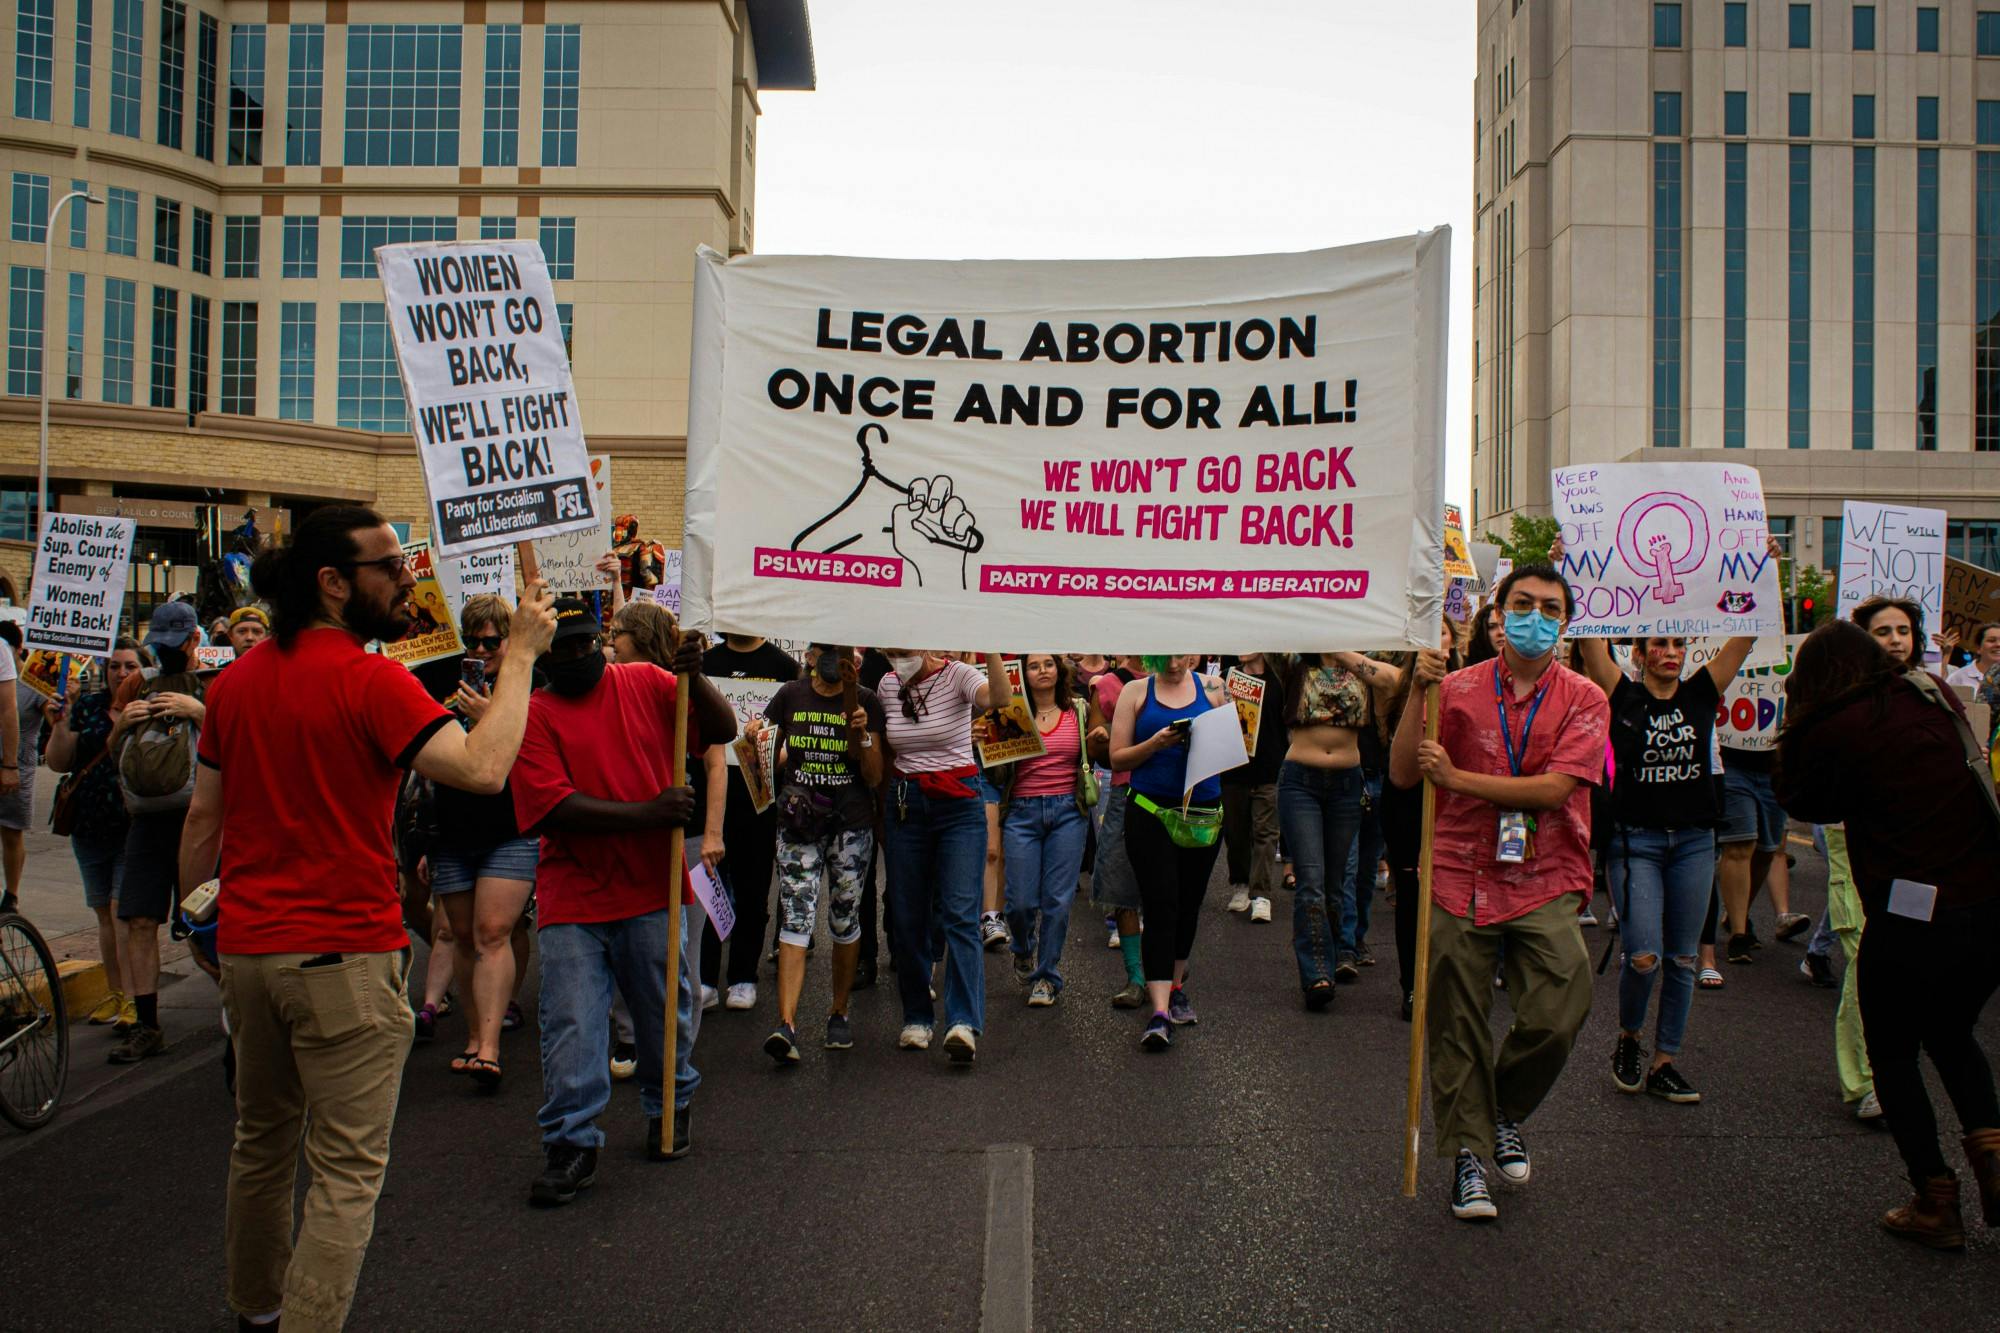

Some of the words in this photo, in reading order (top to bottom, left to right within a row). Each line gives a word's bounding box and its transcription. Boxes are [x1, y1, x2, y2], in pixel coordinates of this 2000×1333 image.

[414, 254, 521, 296] WOMEN
[407, 299, 497, 343] WON'T
[505, 296, 543, 335] GO
[816, 307, 1003, 360] LEGAL
[1019, 314, 1317, 363] ABORTION
[447, 343, 529, 386] BACK,
[767, 368, 936, 420] ONCE
[953, 383, 1083, 426] AND
[1106, 387, 1221, 429] FOR
[1238, 379, 1357, 428] ALL!
[420, 400, 499, 445] WE'LL
[501, 391, 569, 434] FIGHT
[461, 436, 554, 487] BACK!
[1044, 460, 1080, 492] WE
[1091, 458, 1187, 493] WON'T
[1197, 455, 1241, 493] GO
[1256, 446, 1356, 492] BACK
[1555, 471, 1598, 488] KEEP
[445, 500, 475, 519] Party
[477, 496, 494, 512] for
[496, 489, 544, 510] Socialism
[554, 488, 588, 519] PSL
[1561, 485, 1600, 503] YOUR
[162, 510, 194, 519] COUNT
[1571, 503, 1603, 515] LAWS
[49, 517, 102, 538] Abolish
[105, 523, 125, 539] the
[460, 517, 481, 537] and
[483, 510, 537, 533] Liberation
[1020, 499, 1056, 530] WE
[1065, 501, 1124, 536] WILL
[1136, 504, 1228, 541] FIGHT
[1240, 504, 1353, 549] BACK!
[1560, 521, 1603, 546] OFF
[1849, 509, 1908, 545] WE
[1907, 525, 1939, 537] WILL
[43, 536, 73, 558] Sup.
[1719, 528, 1767, 550] OFF
[48, 557, 96, 581] Enemy
[99, 561, 114, 582] of
[492, 567, 502, 582] of
[759, 554, 897, 580] PSLWEB.ORG
[1562, 546, 1614, 582] MY
[1718, 552, 1770, 583] MY
[1871, 548, 1941, 584] NOT
[567, 573, 603, 592] Rights
[989, 571, 1051, 588] PARTY
[1058, 574, 1098, 590] FOR
[1104, 575, 1216, 592] SOCIALISM
[1221, 577, 1234, 592] &
[1241, 577, 1362, 593] LIBERATION
[46, 584, 105, 607] Women!
[1871, 580, 1941, 613] BACK!
[31, 605, 67, 628] Fight
[71, 610, 113, 631] Back!
[1568, 624, 1630, 637] SEPARATION
[1637, 624, 1652, 634] OF
[1656, 618, 1710, 634] CHURCH
[198, 648, 218, 658] PRO
[1740, 681, 1765, 696] OFF
[793, 712, 806, 722] AND
[808, 712, 821, 722] YOU
[1650, 708, 1684, 730] MIND
[813, 725, 828, 735] WAS
[830, 727, 835, 736] A
[1646, 725, 1697, 747] YOUR
[789, 735, 817, 748] NASTY
[820, 739, 848, 752] WOMA
[1643, 745, 1694, 762] OWN
[804, 751, 839, 763] BEFORE?
[1633, 763, 1701, 783] UTERUS
